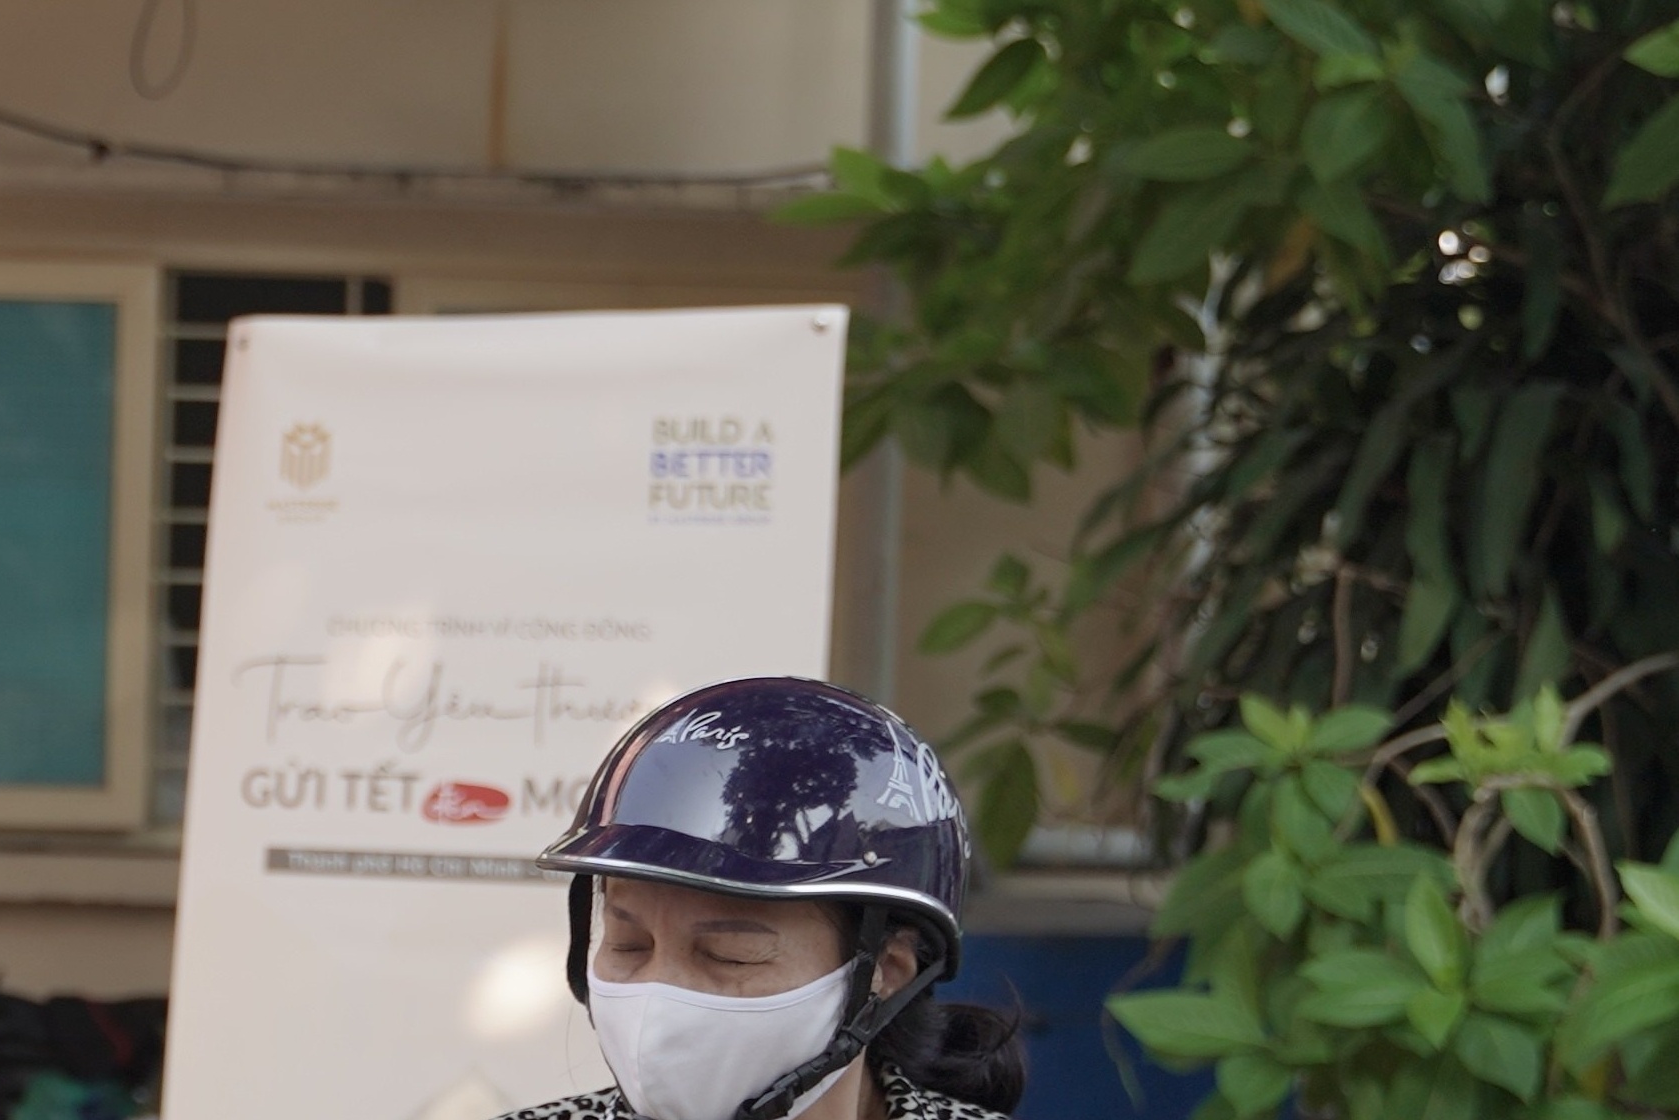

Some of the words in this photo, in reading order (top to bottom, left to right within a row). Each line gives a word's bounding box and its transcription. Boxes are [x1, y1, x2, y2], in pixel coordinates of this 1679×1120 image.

[652, 416, 745, 445] BUILD
[753, 419, 774, 445] A
[650, 450, 772, 478] BETTER
[648, 483, 772, 512] FUTURE
[680, 712, 749, 750] Paris
[342, 760, 421, 812] TẾT
